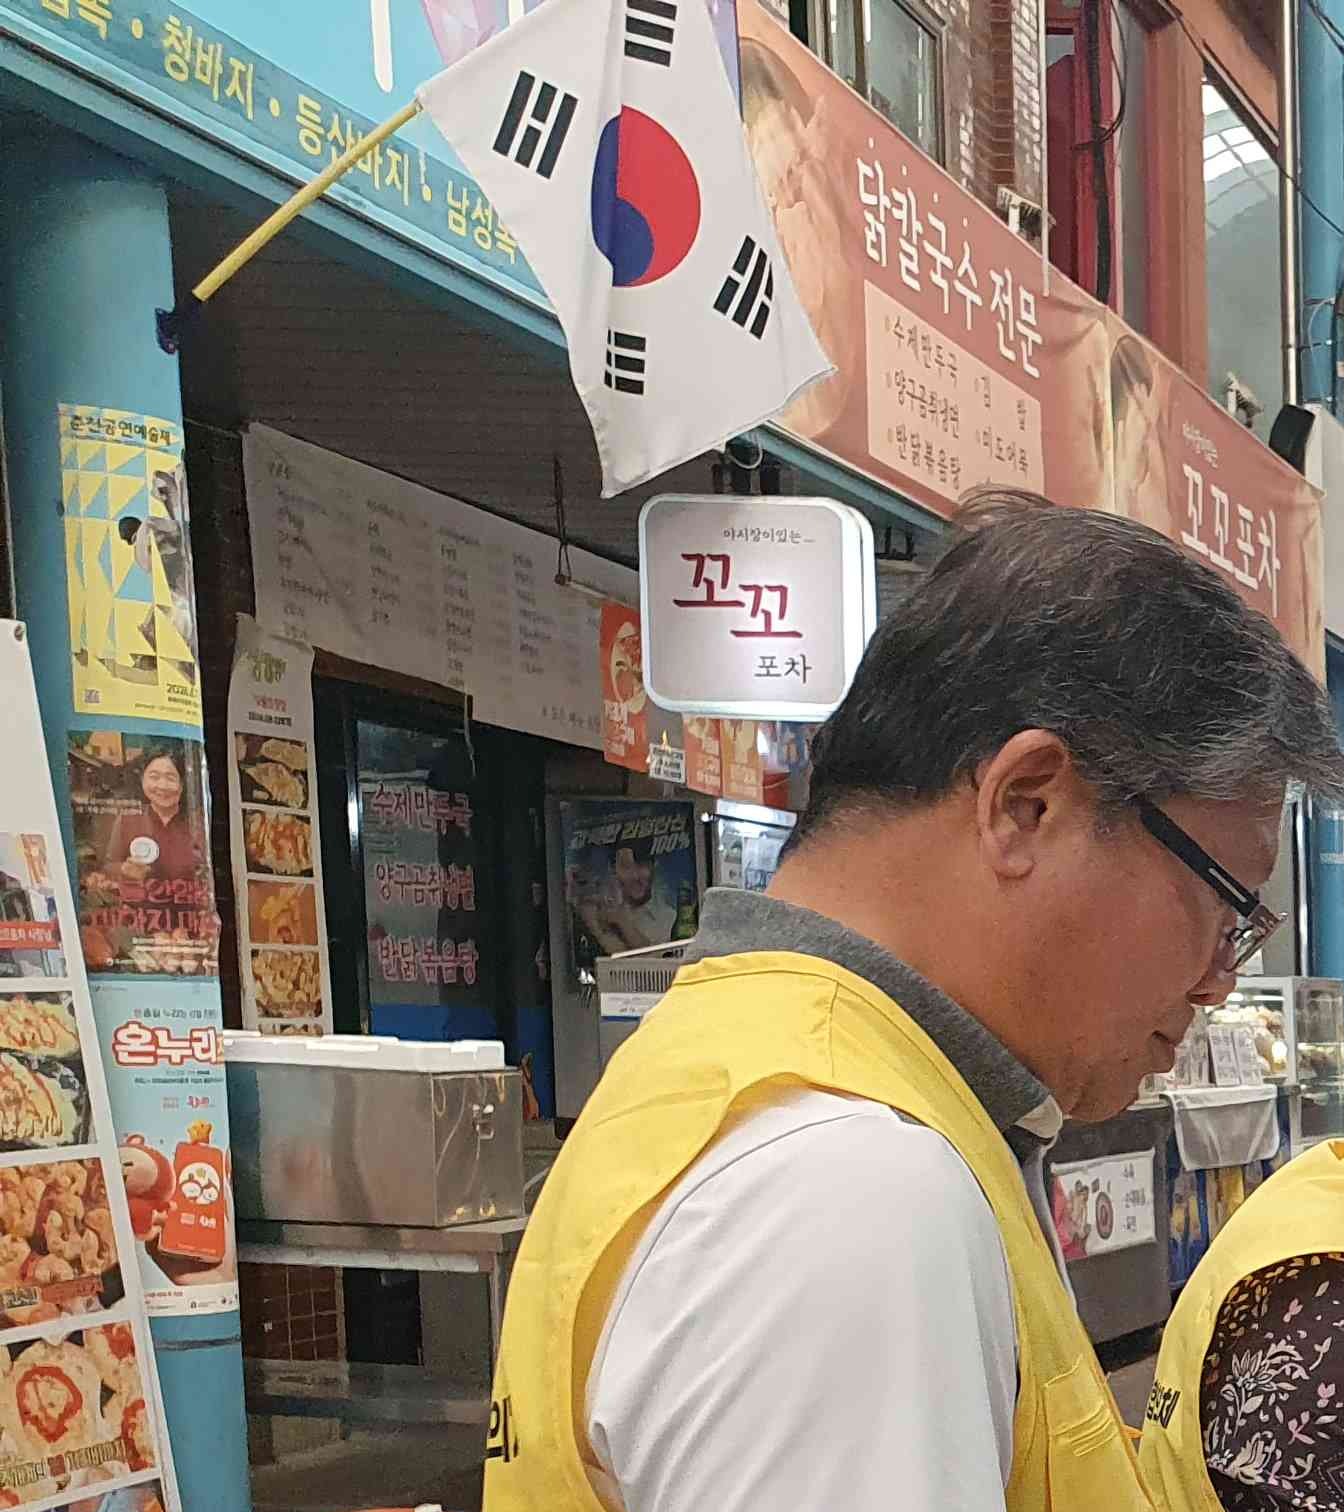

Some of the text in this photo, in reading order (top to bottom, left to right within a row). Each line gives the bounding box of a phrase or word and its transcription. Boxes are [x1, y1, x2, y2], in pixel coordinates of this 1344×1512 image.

[160, 15, 254, 120] 청바지
[295, 94, 411, 206] 등산바지
[856, 157, 1043, 379] 닭칼국수 전문
[673, 552, 803, 639] 꼬꼬
[1180, 463, 1281, 619] 꼬꼬포차
[753, 654, 812, 684] 포차
